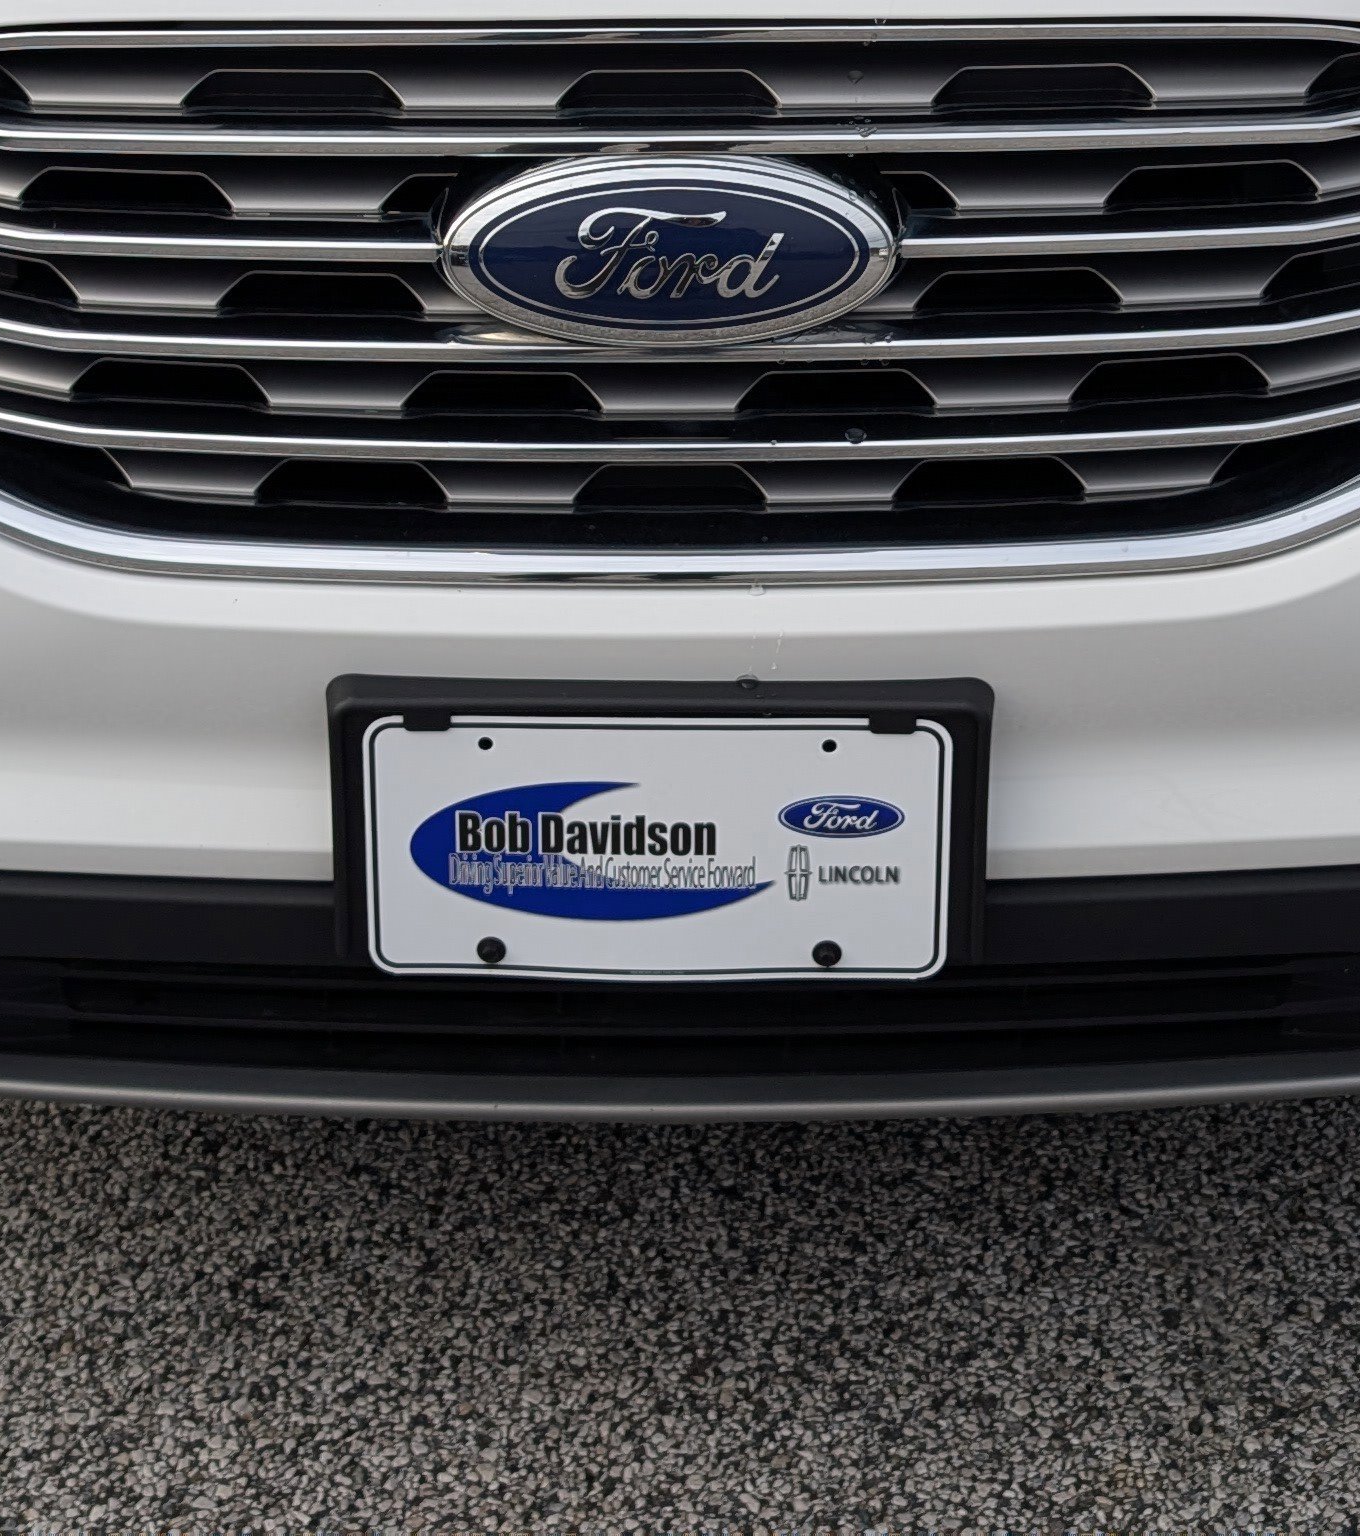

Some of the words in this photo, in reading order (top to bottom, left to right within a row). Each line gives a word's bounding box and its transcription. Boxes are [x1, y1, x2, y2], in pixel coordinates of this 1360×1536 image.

[554, 207, 786, 300] Ford
[458, 812, 531, 853] Bob
[541, 813, 717, 856] Davidson
[802, 801, 880, 830] Ford
[449, 852, 493, 894] Driving
[493, 853, 543, 895] Superior
[578, 855, 604, 889] And
[604, 856, 662, 889] Customer
[663, 857, 706, 889] Service
[707, 855, 756, 889] Forward
[818, 865, 900, 884] LINCOLN
